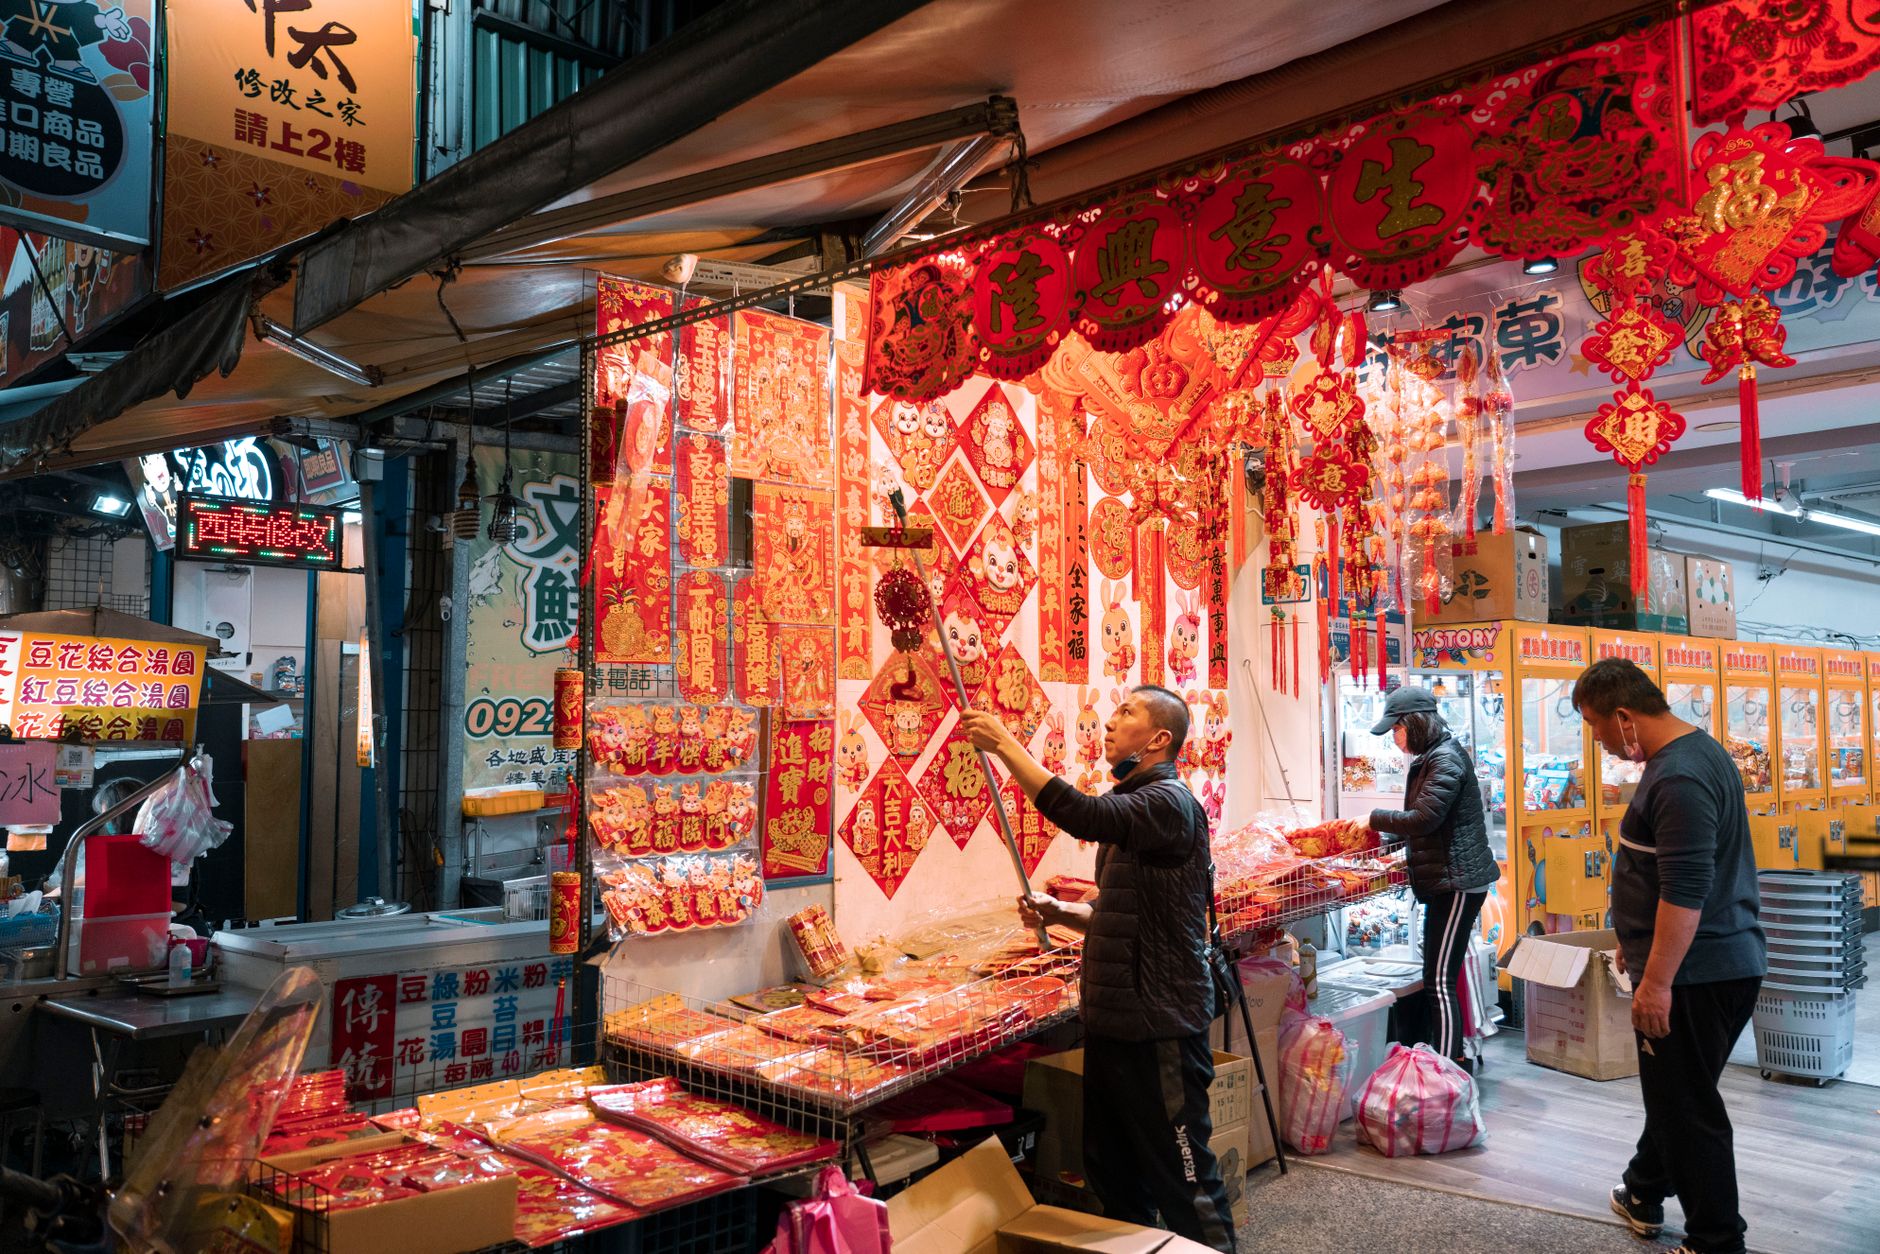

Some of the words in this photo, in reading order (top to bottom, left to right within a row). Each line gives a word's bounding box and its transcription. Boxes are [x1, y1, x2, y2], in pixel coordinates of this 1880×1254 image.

[9, 67, 75, 109] 專營
[234, 67, 366, 127] 修改之家
[233, 107, 366, 176] 請上2樓
[988, 137, 1447, 336] 生意興隆
[197, 511, 329, 552] 西裝修改
[24, 640, 196, 676] 豆花綜合湯圓
[687, 587, 714, 691] 一帆風順
[1433, 627, 1498, 650] STORY
[19, 676, 191, 710] 紅豆綜合湯圓
[464, 697, 555, 738] 092
[626, 738, 725, 769] 新年快樂
[808, 723, 833, 785] 招財
[944, 738, 984, 799] 福
[630, 812, 726, 849] 五福臨門
[883, 776, 902, 877] 大吉大利
